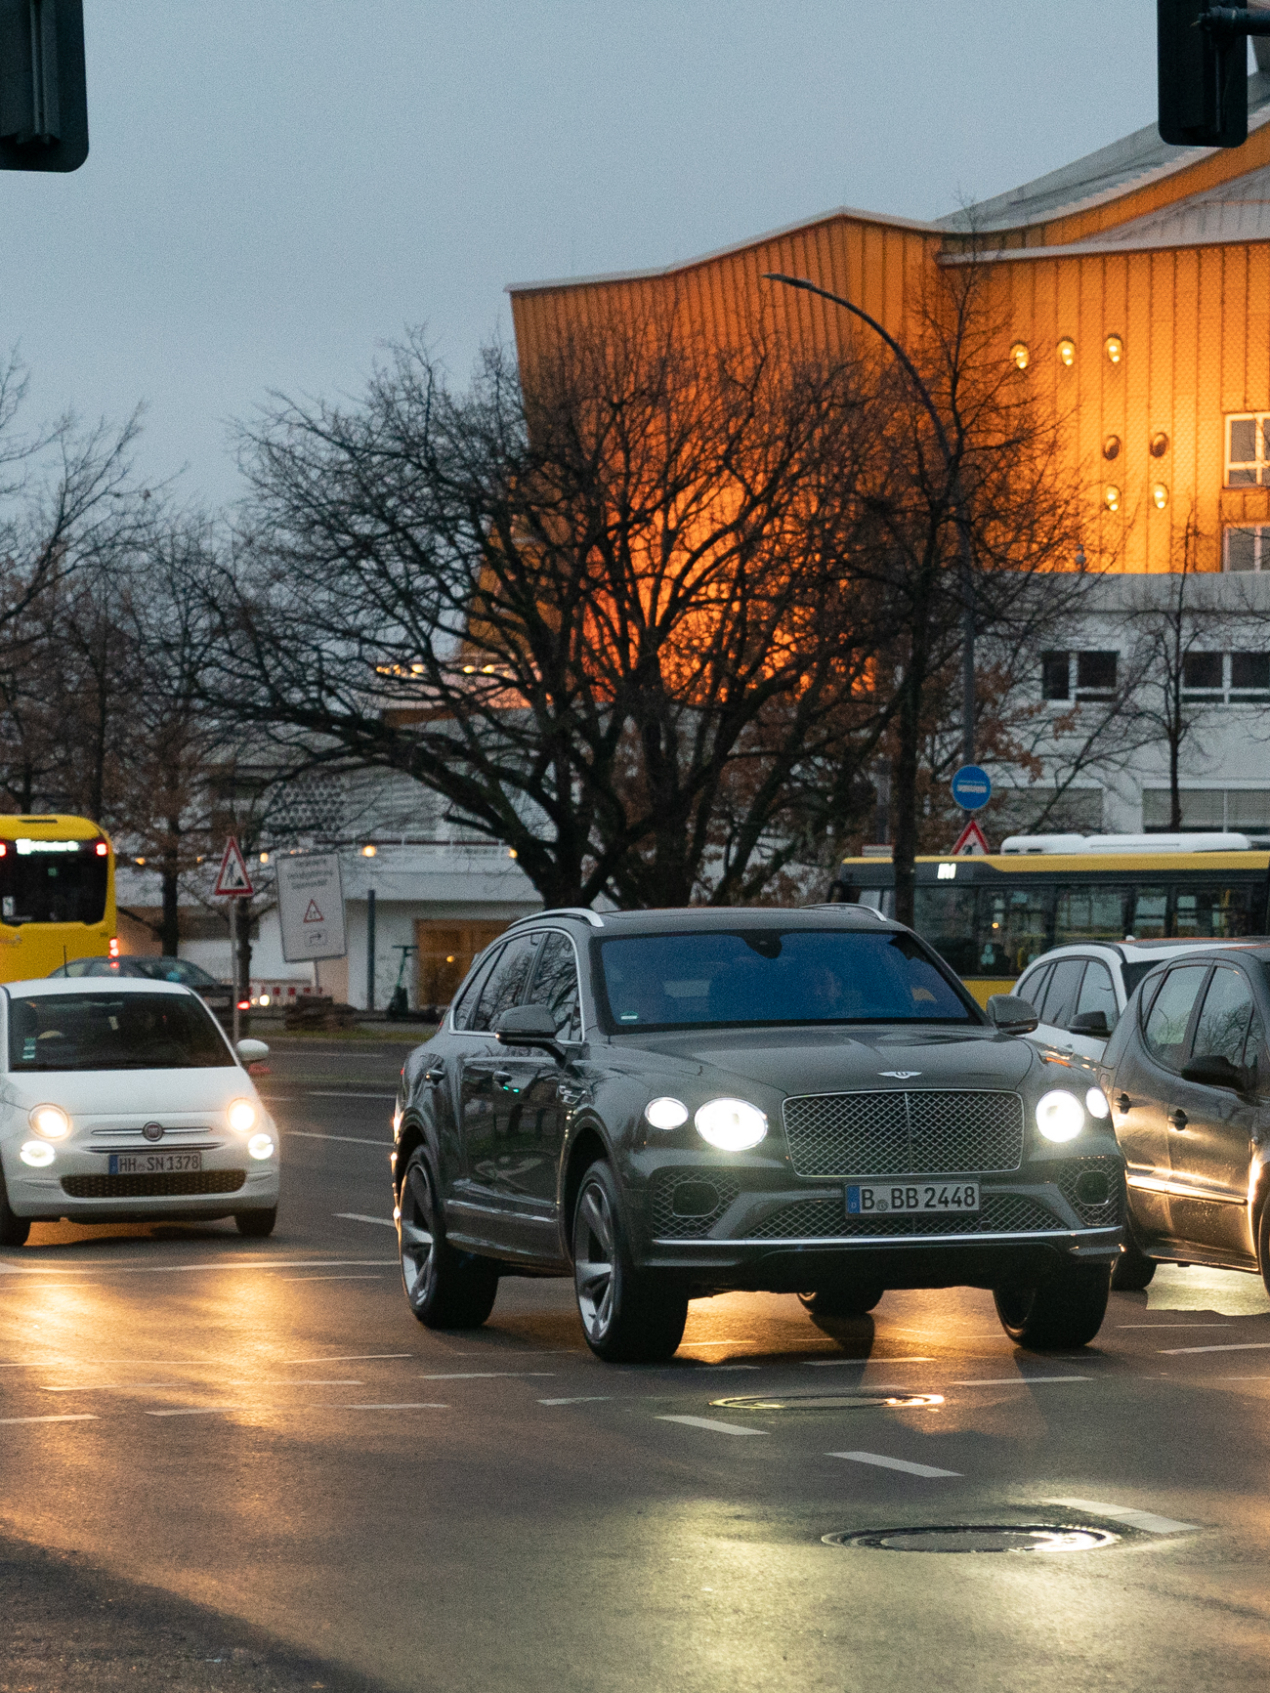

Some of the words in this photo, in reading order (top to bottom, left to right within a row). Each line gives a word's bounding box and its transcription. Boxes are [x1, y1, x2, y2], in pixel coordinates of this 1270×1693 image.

[120, 1157, 136, 1172] HH
[146, 1156, 164, 1171] SN
[166, 1155, 199, 1170] 1378
[861, 1189, 875, 1210] B
[891, 1187, 919, 1209] BB
[924, 1186, 976, 1208] 2448
